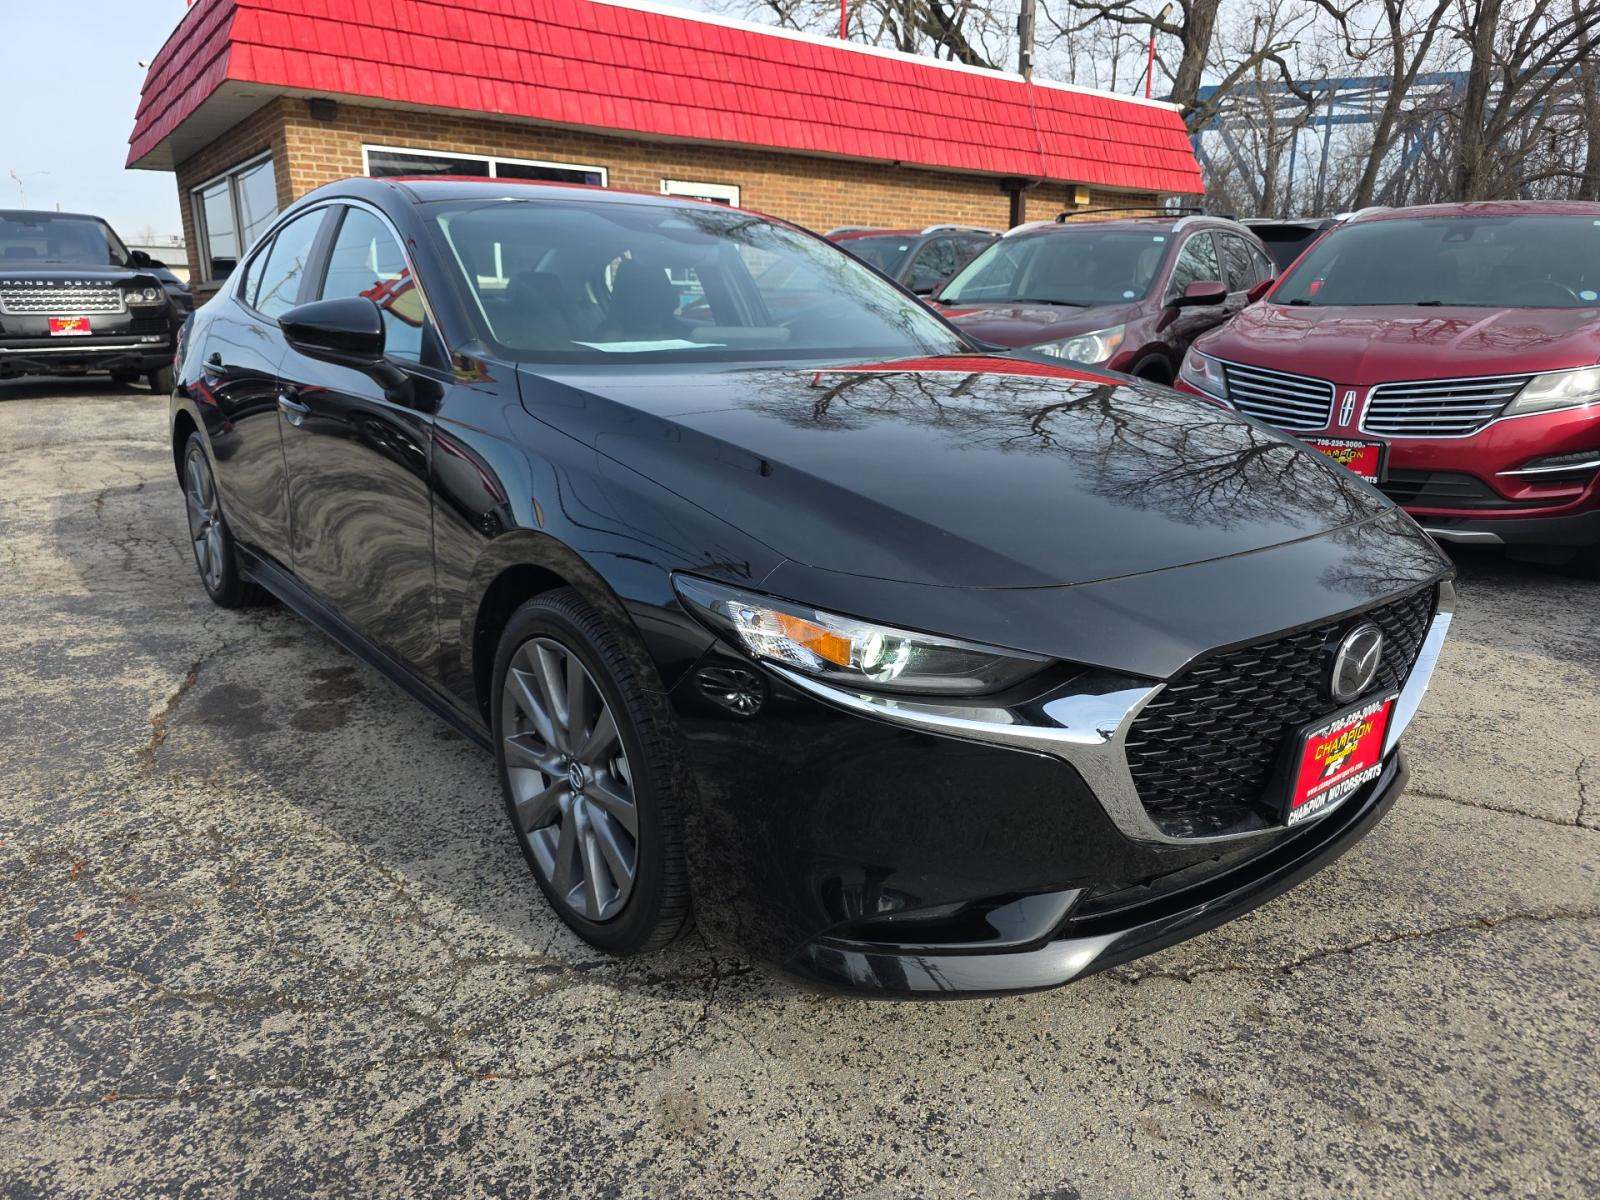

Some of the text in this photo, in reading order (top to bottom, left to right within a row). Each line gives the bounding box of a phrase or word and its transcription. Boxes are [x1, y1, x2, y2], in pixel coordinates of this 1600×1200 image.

[1314, 720, 1374, 761] CHAMPION
[1287, 792, 1327, 827] CHAMPION
[1328, 763, 1383, 801] MOTORSPORTS
